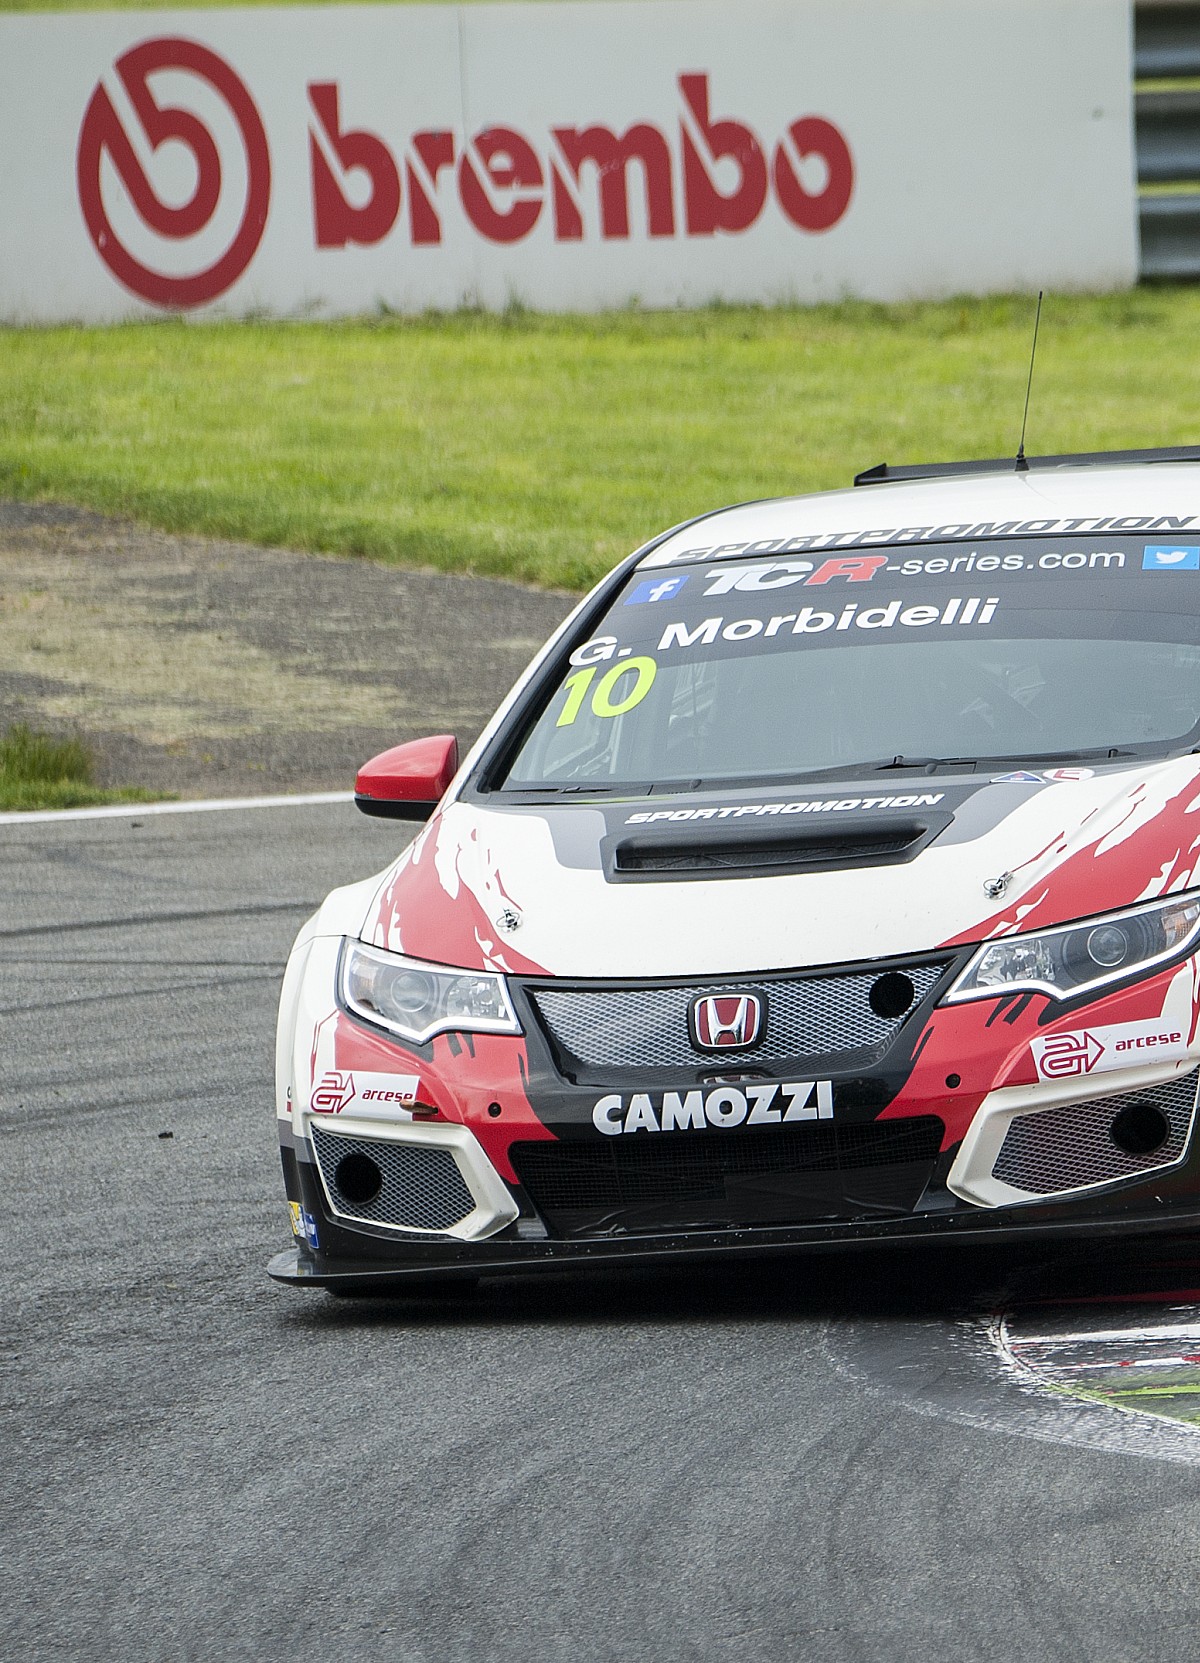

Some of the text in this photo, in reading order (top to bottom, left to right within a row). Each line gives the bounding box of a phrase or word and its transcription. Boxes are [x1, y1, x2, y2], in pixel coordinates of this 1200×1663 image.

[307, 72, 854, 249] brembo
[671, 516, 1199, 563] SPORTPROMOTION
[569, 597, 999, 668] G. Morbidelli
[555, 656, 657, 728] 10
[625, 793, 944, 825] SPORTPROMOTION
[1115, 1030, 1181, 1052] arcese
[361, 1089, 413, 1103] arcese
[592, 1080, 834, 1136] CAMOZZI
